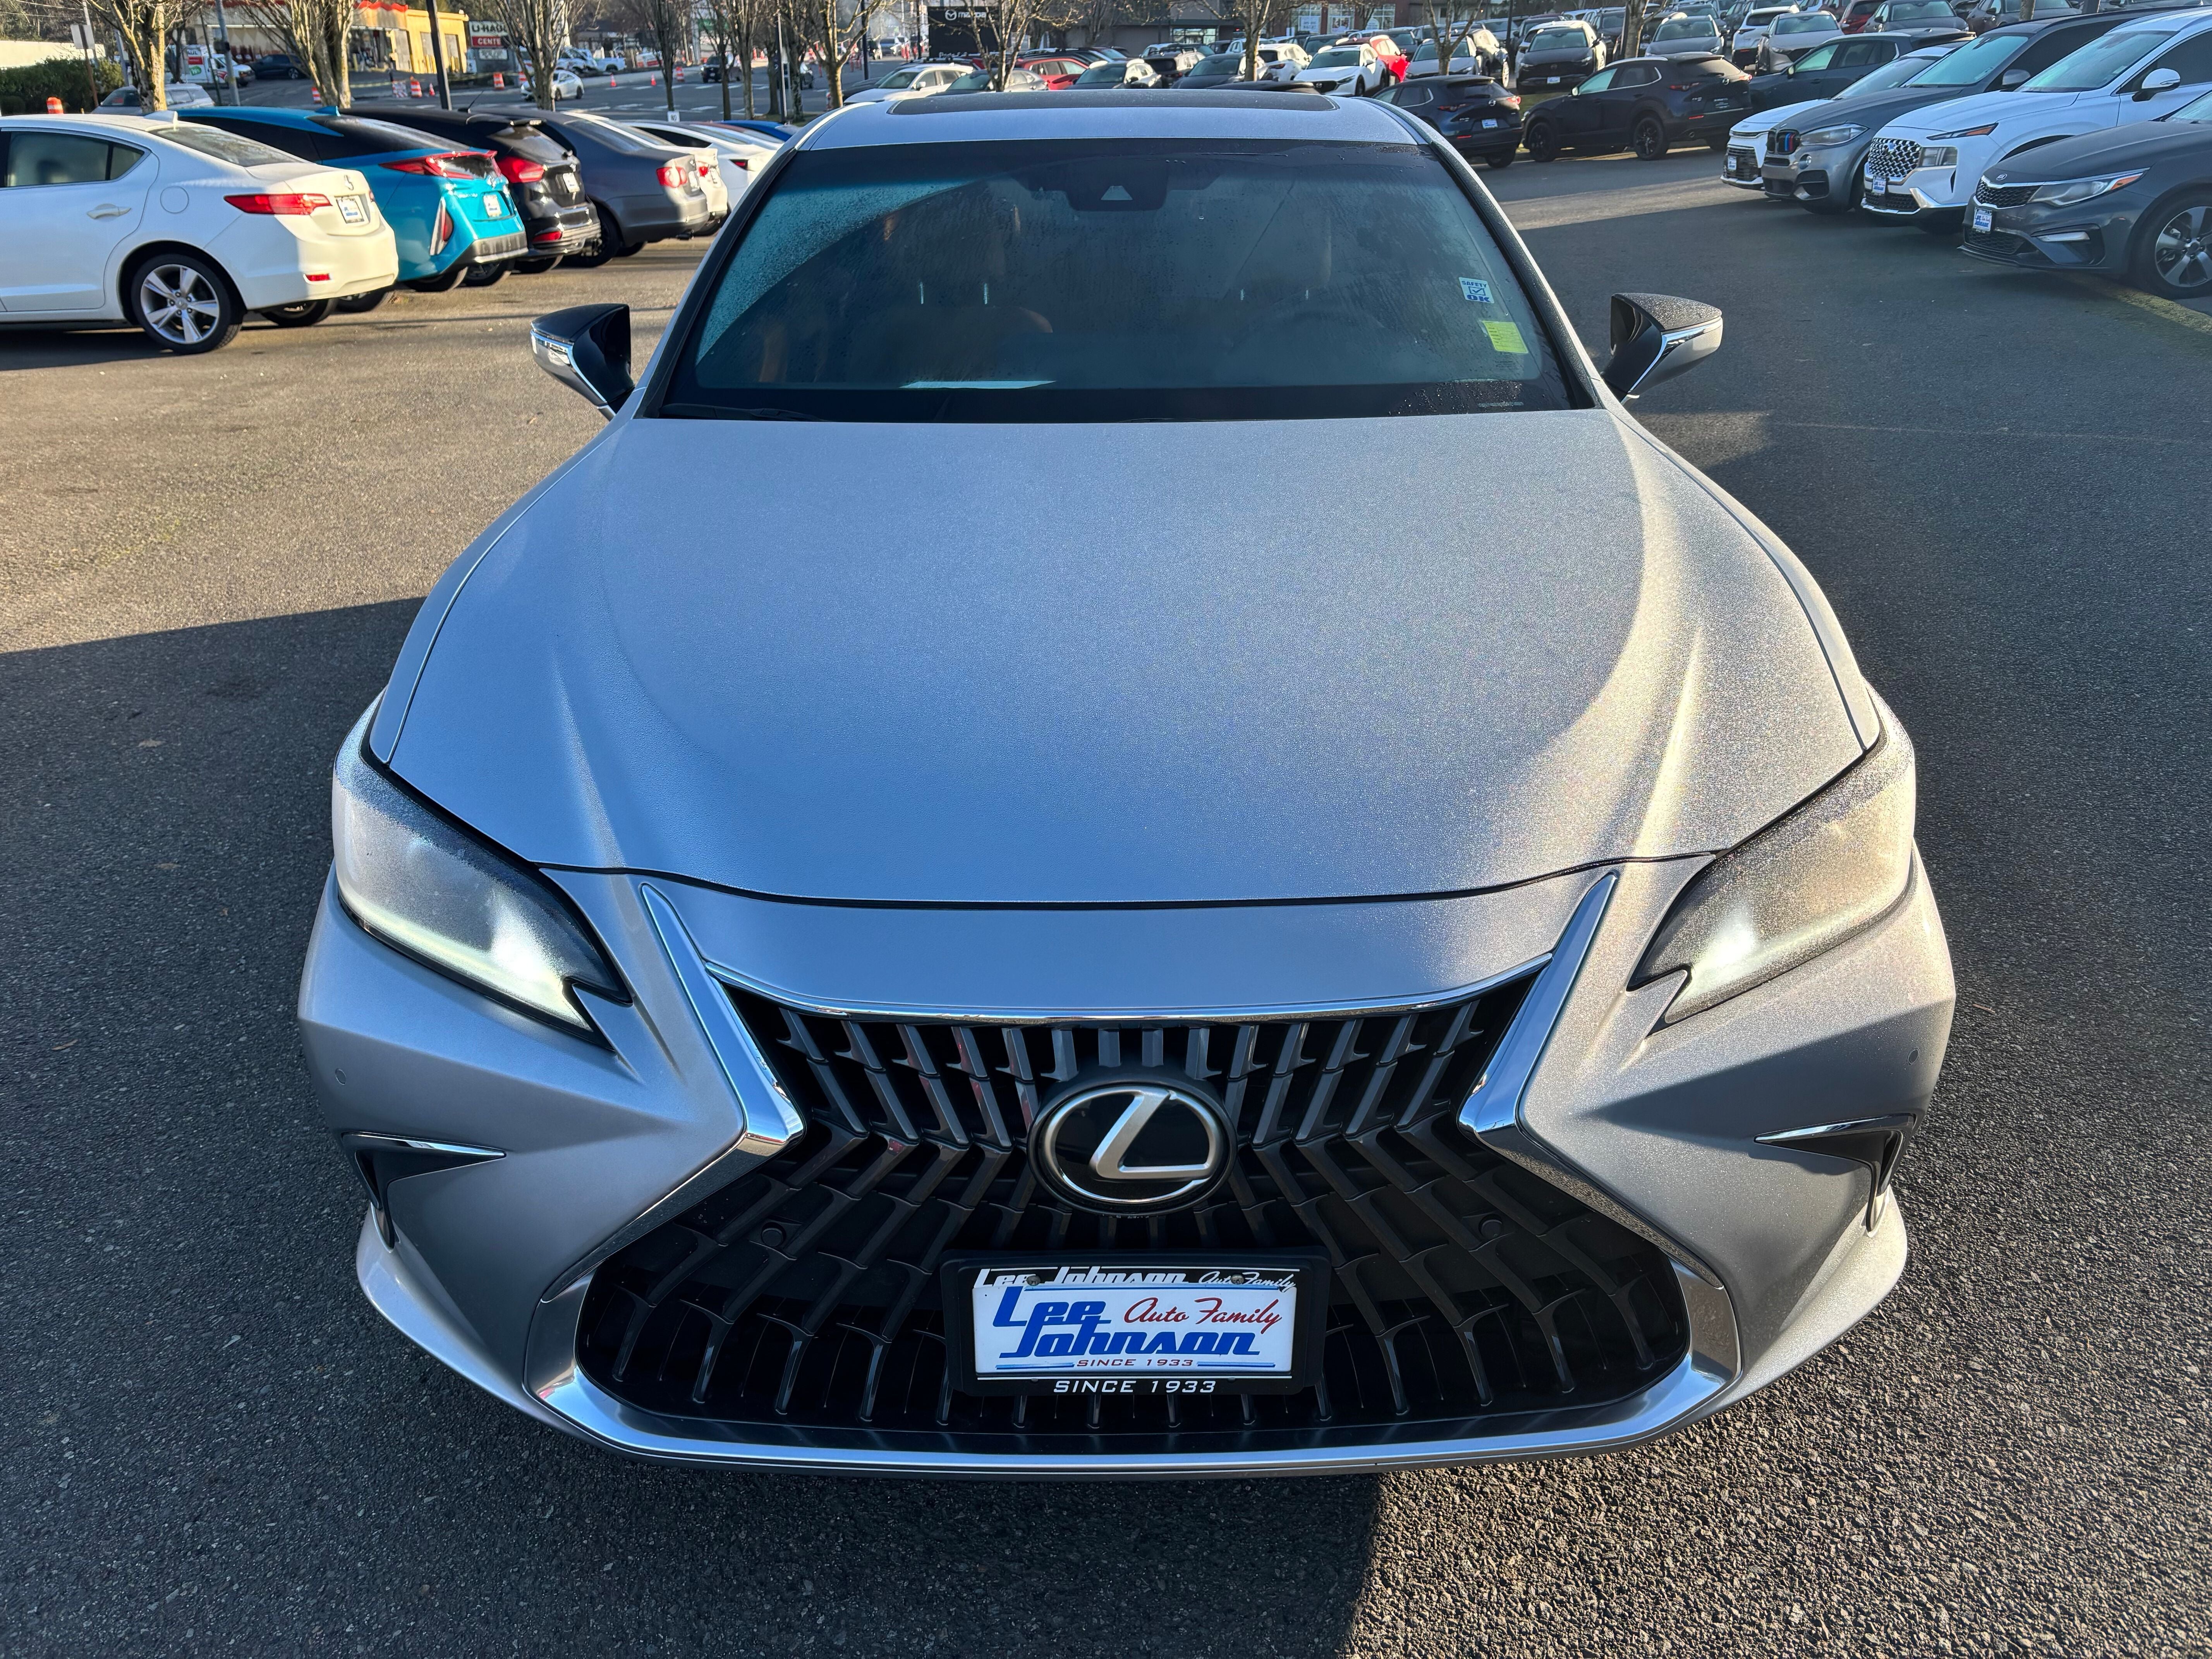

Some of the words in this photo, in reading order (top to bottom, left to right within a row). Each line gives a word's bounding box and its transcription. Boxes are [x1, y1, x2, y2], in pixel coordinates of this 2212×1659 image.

[1045, 1266, 1189, 1284] Johnson
[1199, 1271, 1232, 1284] Aut
[1240, 1272, 1296, 1293] Family
[993, 1286, 1112, 1327] Lee
[1124, 1297, 1189, 1323] Auto
[1194, 1297, 1283, 1334] Family
[1000, 1315, 1260, 1358] Johnson
[1053, 1381, 1136, 1393] SINCE
[1151, 1381, 1216, 1393] 1933
